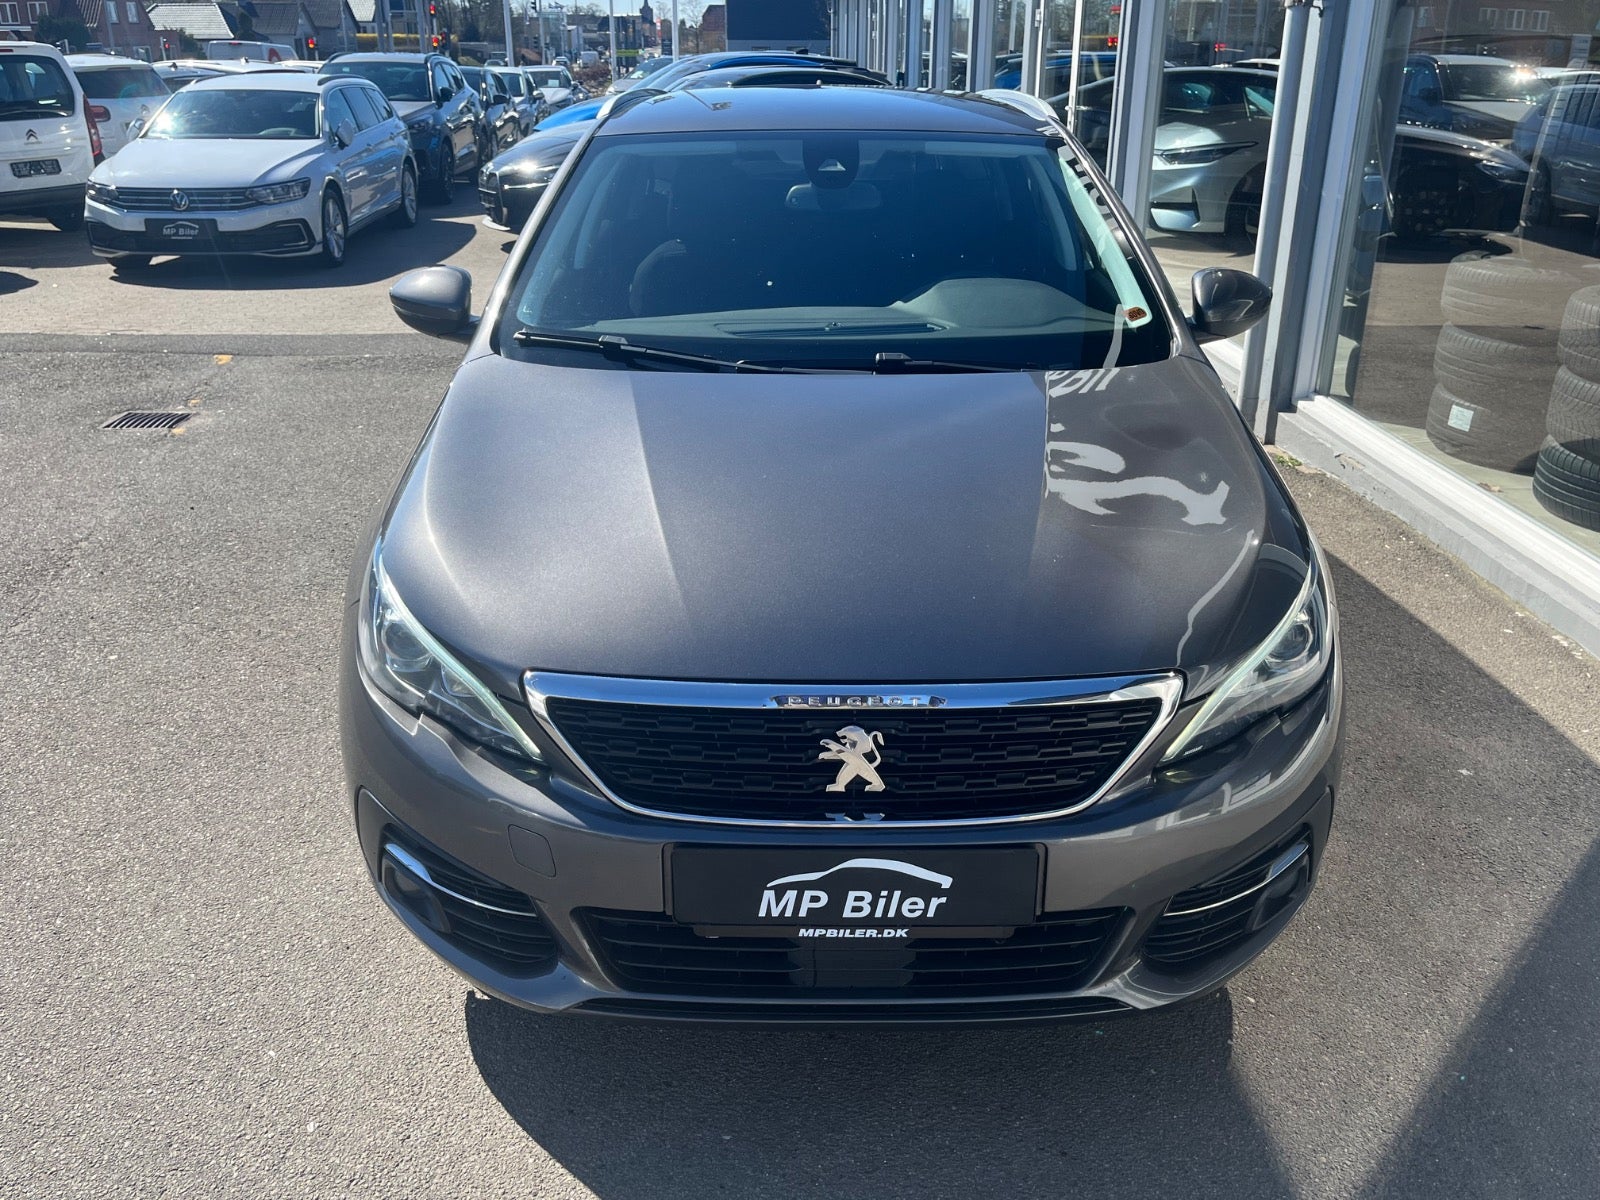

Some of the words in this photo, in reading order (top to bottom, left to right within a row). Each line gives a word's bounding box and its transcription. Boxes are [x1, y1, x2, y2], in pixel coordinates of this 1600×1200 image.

[163, 228, 177, 236] MP
[179, 227, 199, 236] Biler
[788, 695, 922, 707] PEUGEOT
[758, 889, 829, 918] MP
[842, 889, 947, 918] Biler
[798, 928, 910, 938] MPBILER.DK
